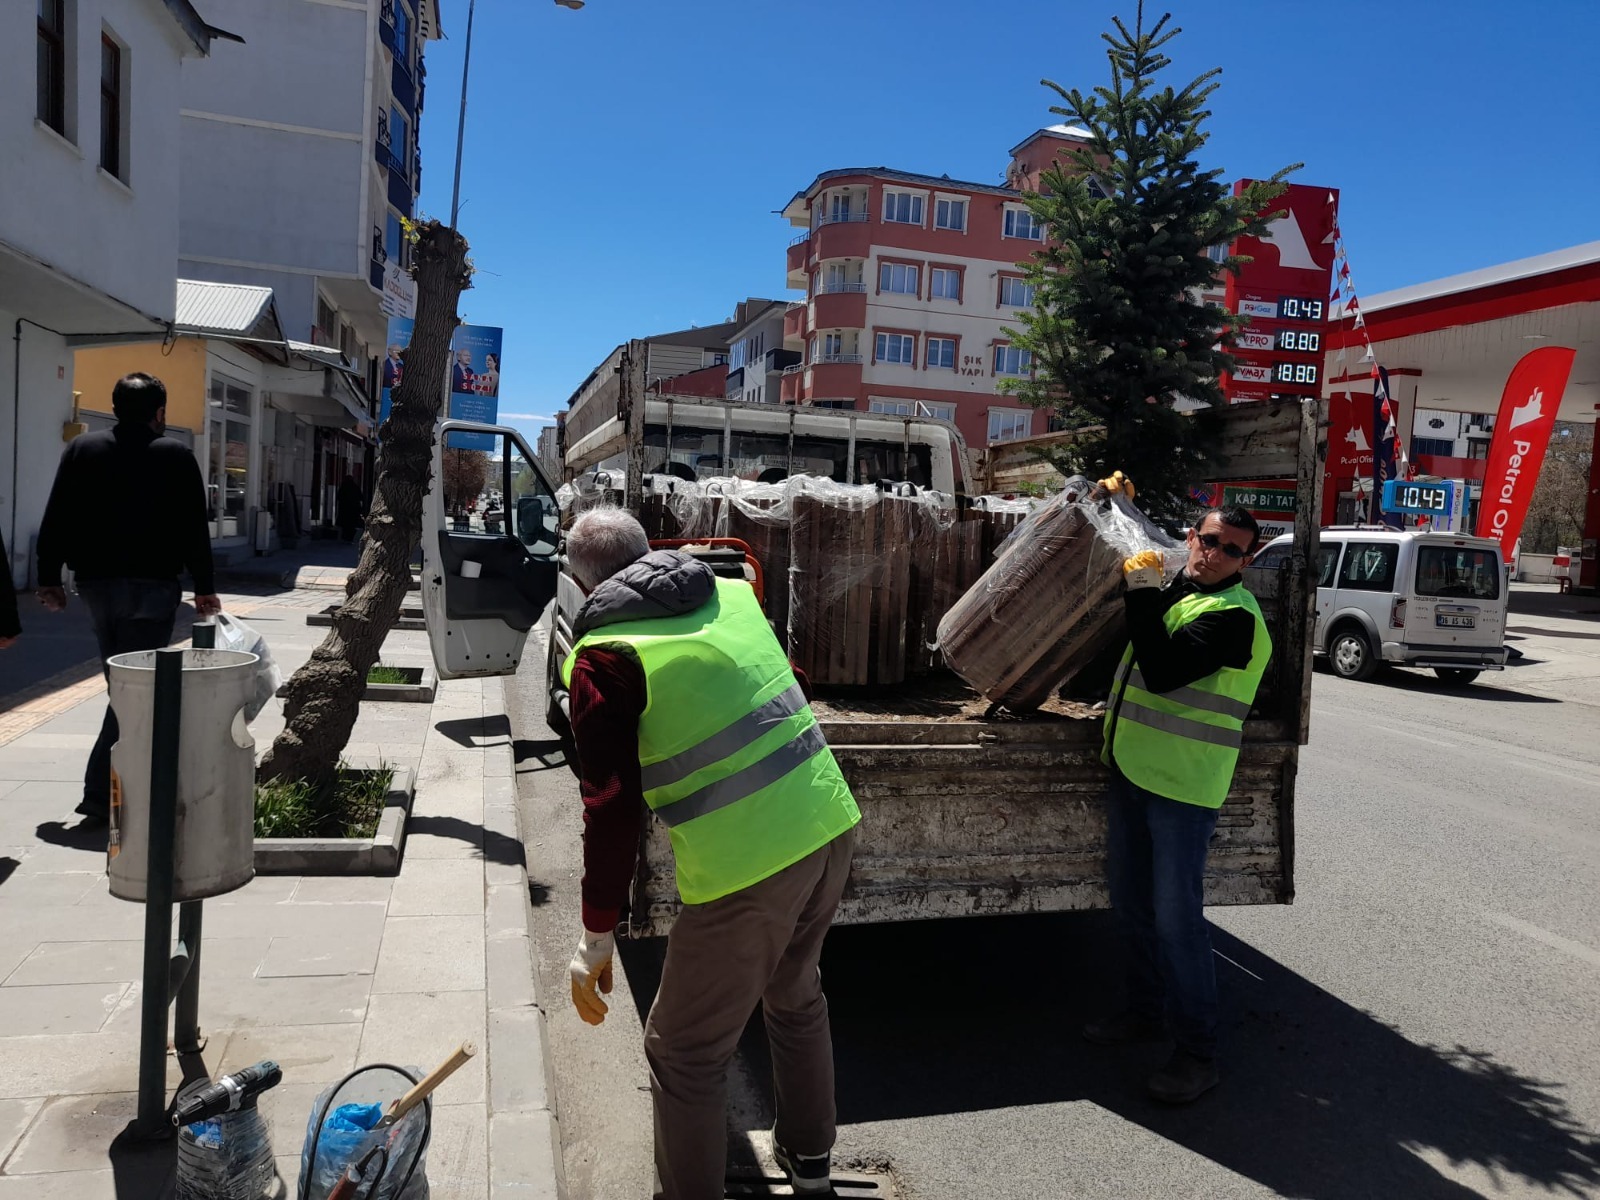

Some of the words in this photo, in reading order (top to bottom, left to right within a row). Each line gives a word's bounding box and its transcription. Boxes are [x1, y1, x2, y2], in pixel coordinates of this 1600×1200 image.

[1283, 299, 1322, 319] 10.43
[1280, 331, 1320, 351] 18.80
[961, 367, 985, 377] YAPI
[1278, 364, 1317, 384] 18.80
[1499, 440, 1531, 504] Petrol
[1235, 493, 1257, 504] KAP
[1276, 496, 1295, 507] TAT
[1403, 487, 1446, 510] 10.43
